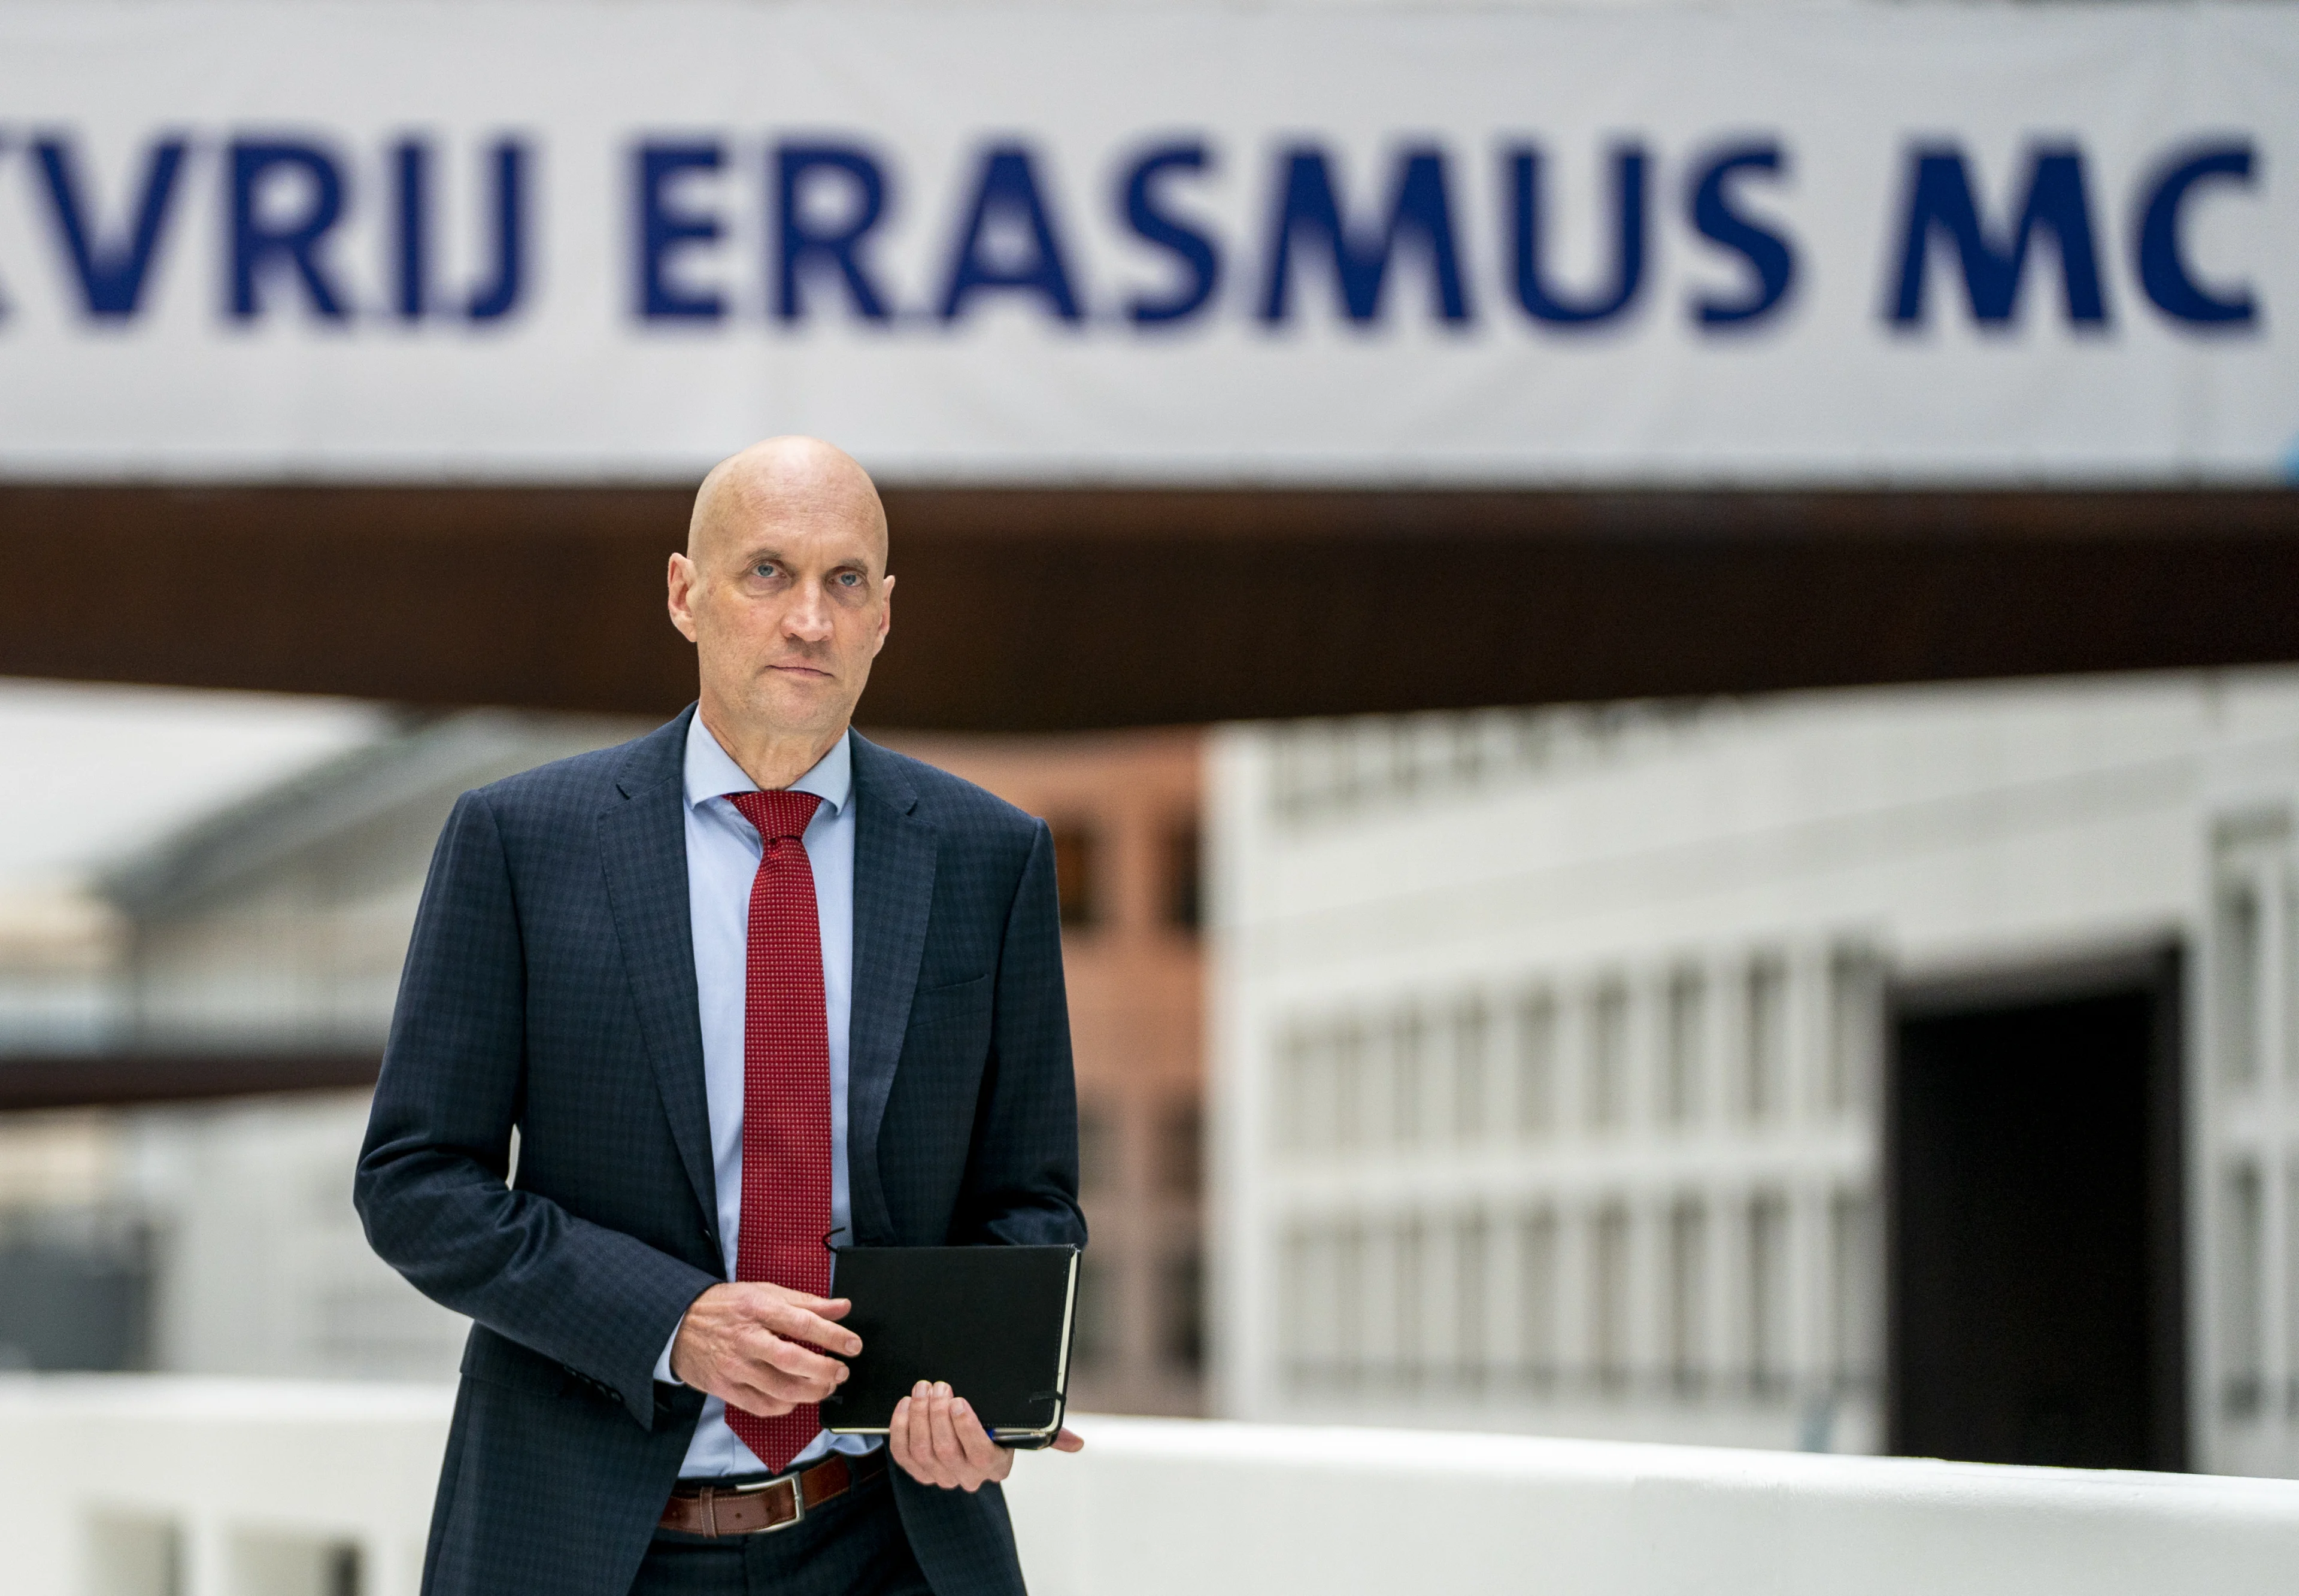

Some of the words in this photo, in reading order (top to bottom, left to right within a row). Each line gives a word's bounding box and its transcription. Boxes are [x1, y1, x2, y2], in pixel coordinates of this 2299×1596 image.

[0, 133, 532, 329] VRIJ
[629, 137, 1803, 338] ERASMUS
[1881, 136, 2263, 339] MC
